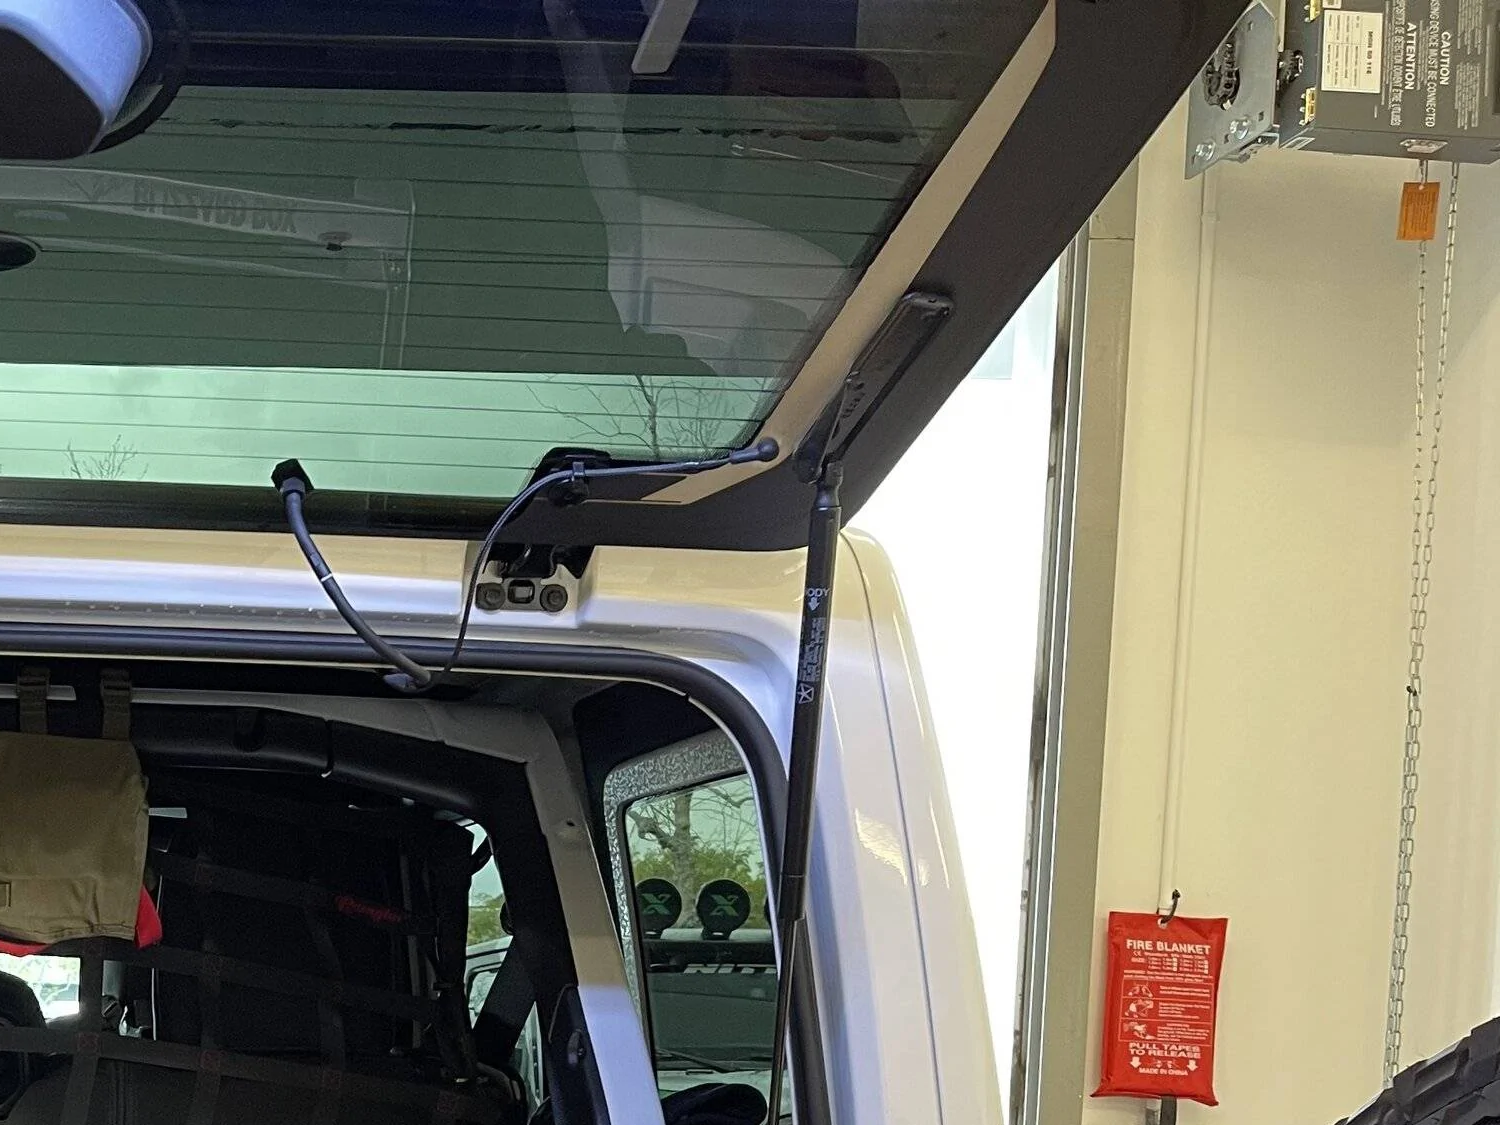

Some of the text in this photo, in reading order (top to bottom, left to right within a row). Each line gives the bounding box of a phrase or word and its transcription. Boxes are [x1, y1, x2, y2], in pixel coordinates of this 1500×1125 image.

[1429, 20, 1440, 48] DEVICE
[1404, 22, 1417, 90] ATTENTION
[1428, 49, 1439, 69] MUST
[1440, 31, 1452, 85] CAUTION
[1427, 70, 1438, 80] BE
[1425, 82, 1437, 127] CONNECTED
[806, 587, 830, 597] ODY
[1126, 939, 1211, 954] FIRE BLANKET
[1129, 1042, 1159, 1050] PULL
[1148, 1049, 1201, 1059] RELEASE
